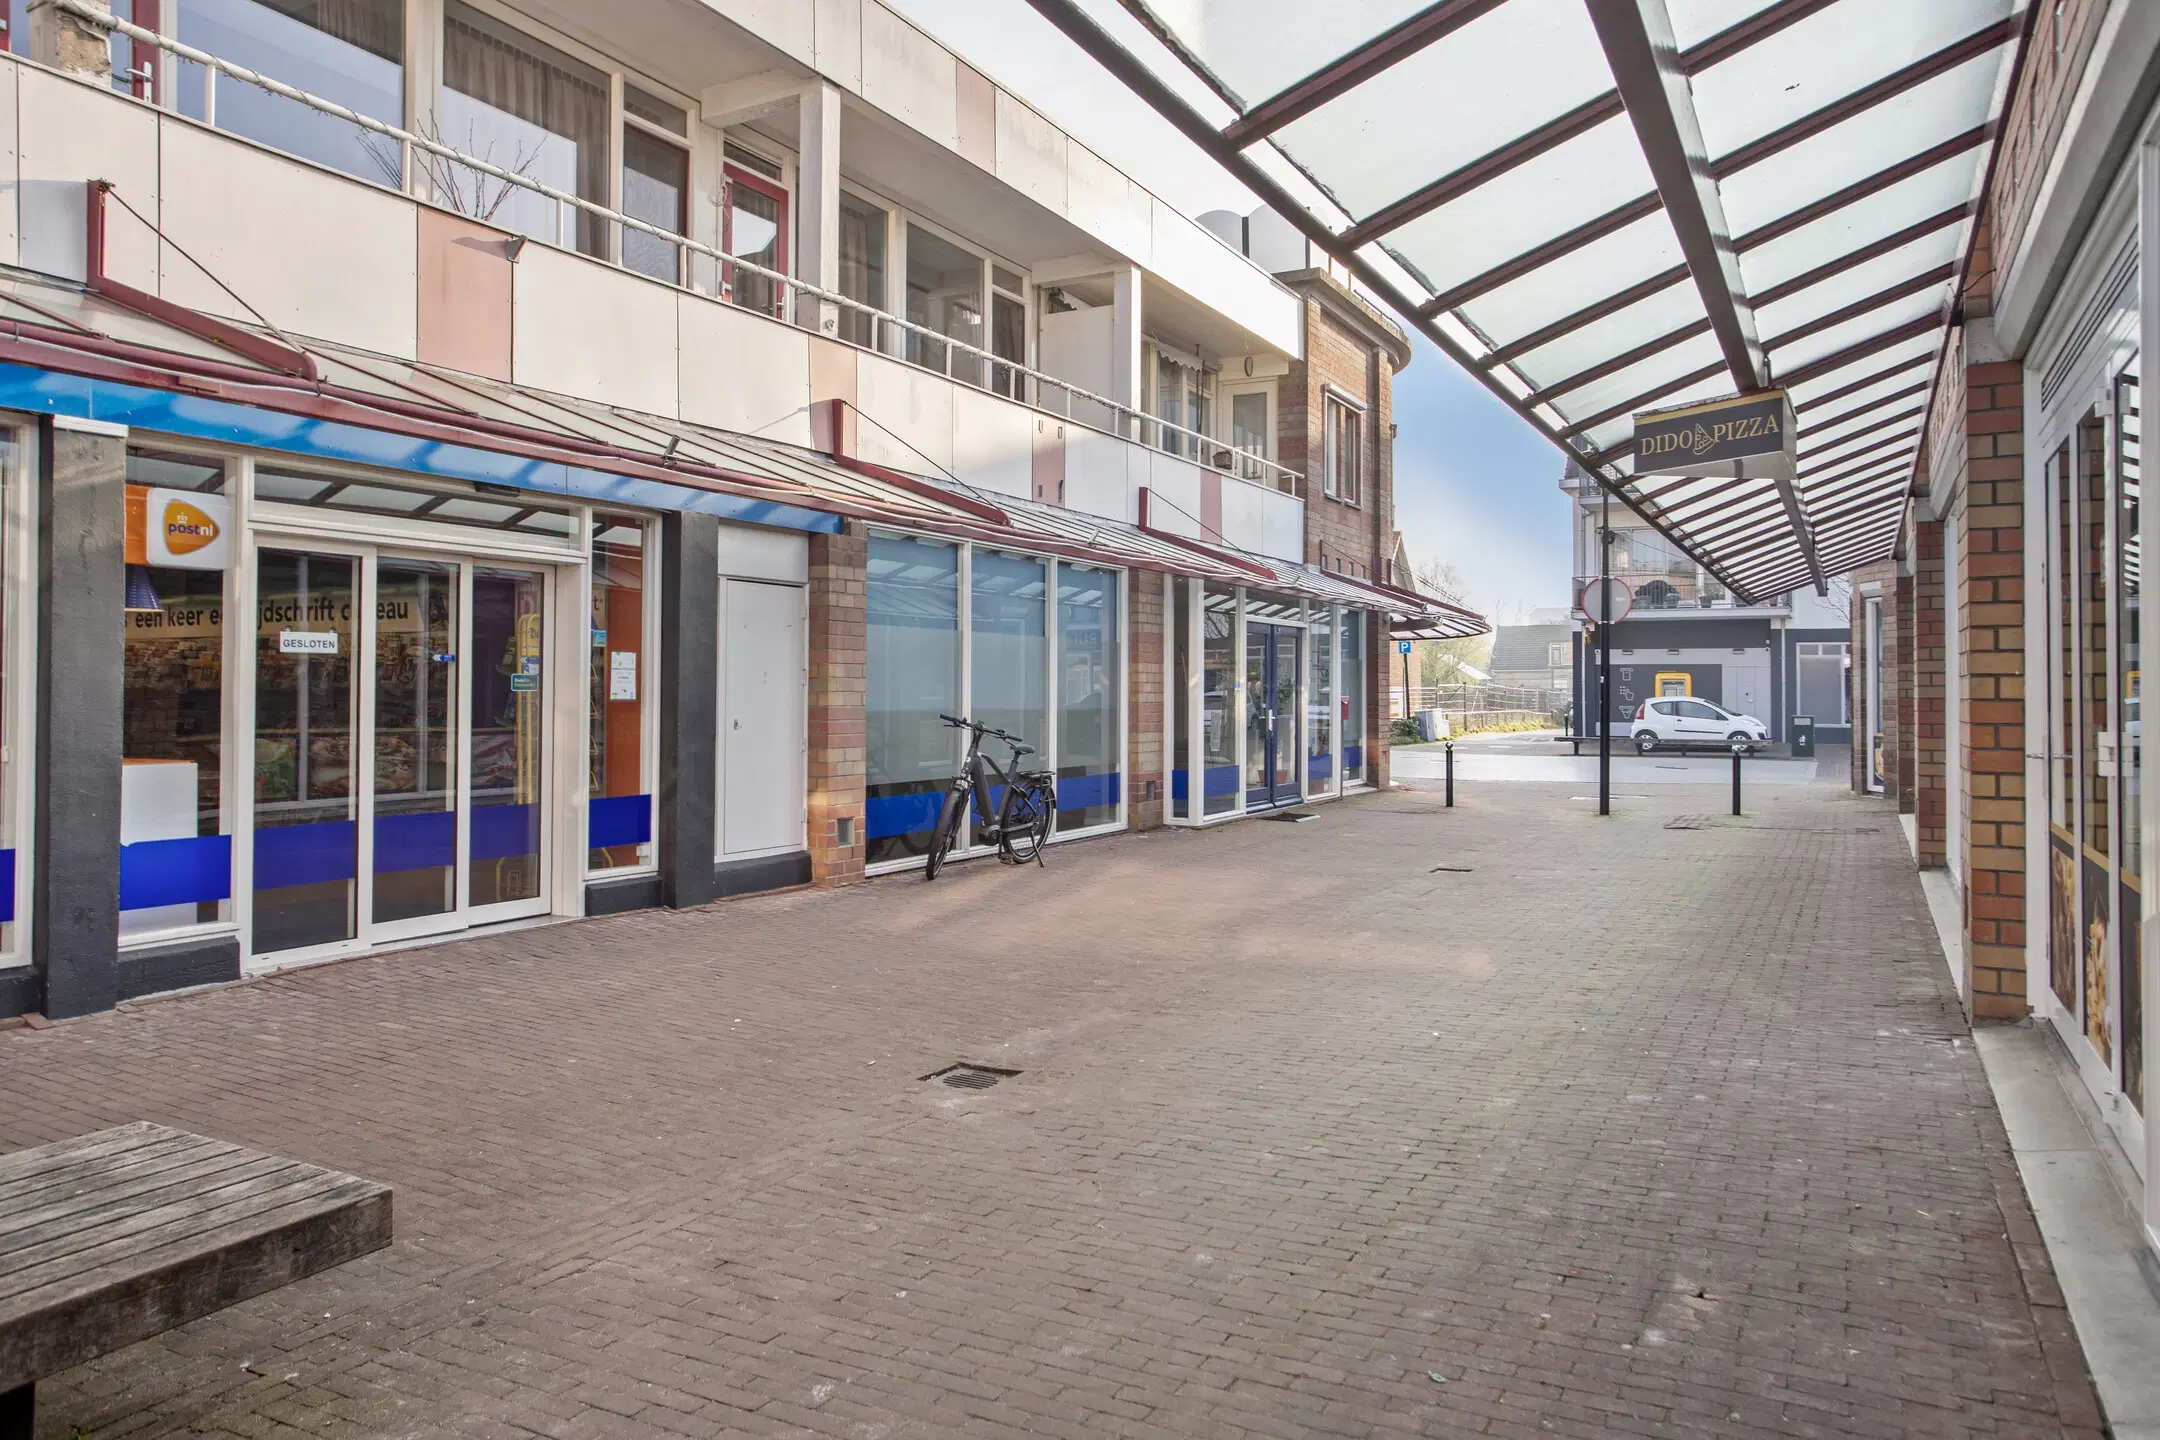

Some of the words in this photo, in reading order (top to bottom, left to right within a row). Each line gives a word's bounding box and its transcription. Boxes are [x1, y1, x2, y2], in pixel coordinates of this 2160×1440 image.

[1640, 430, 1693, 456] DIDO
[1713, 415, 1780, 443] PIZZA
[168, 523, 213, 537] postnl
[136, 611, 162, 628] een
[168, 606, 203, 627] keer
[258, 597, 334, 630] jdschrift
[283, 639, 335, 648] GESLOTEN
[1401, 642, 1408, 652] P
